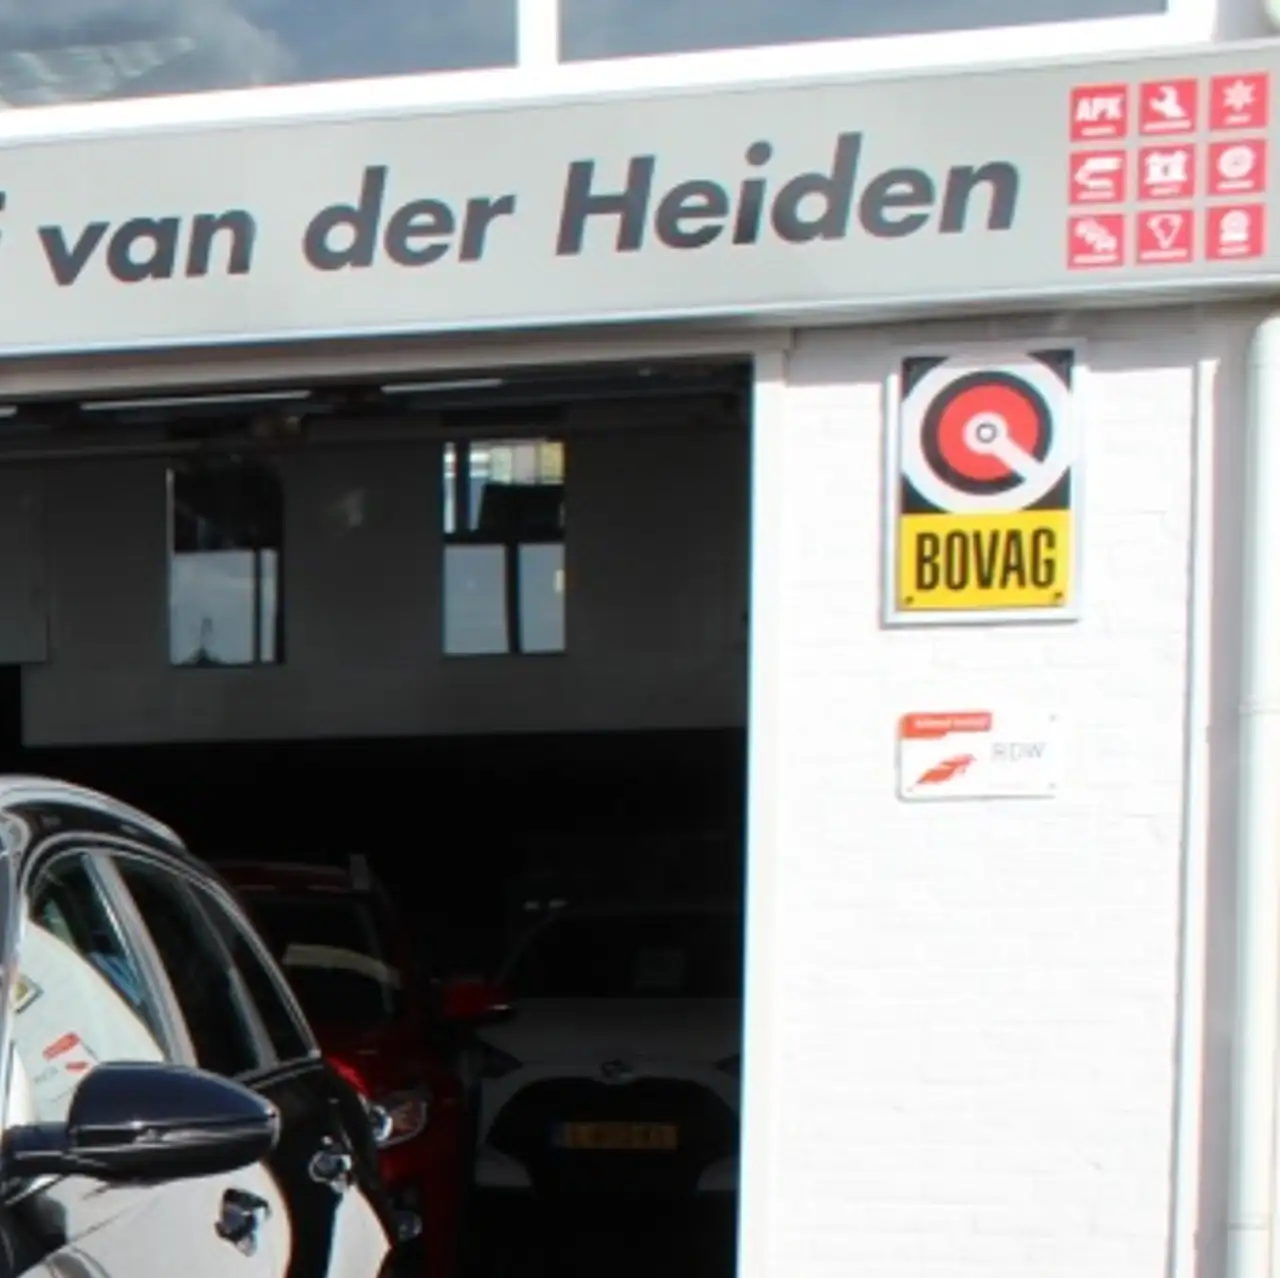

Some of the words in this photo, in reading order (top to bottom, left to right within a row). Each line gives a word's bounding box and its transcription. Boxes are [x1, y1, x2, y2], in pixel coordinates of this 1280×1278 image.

[38, 208, 256, 285] van
[302, 165, 515, 273] der
[556, 132, 1019, 256] Heiden
[915, 527, 1055, 591] BOVAG
